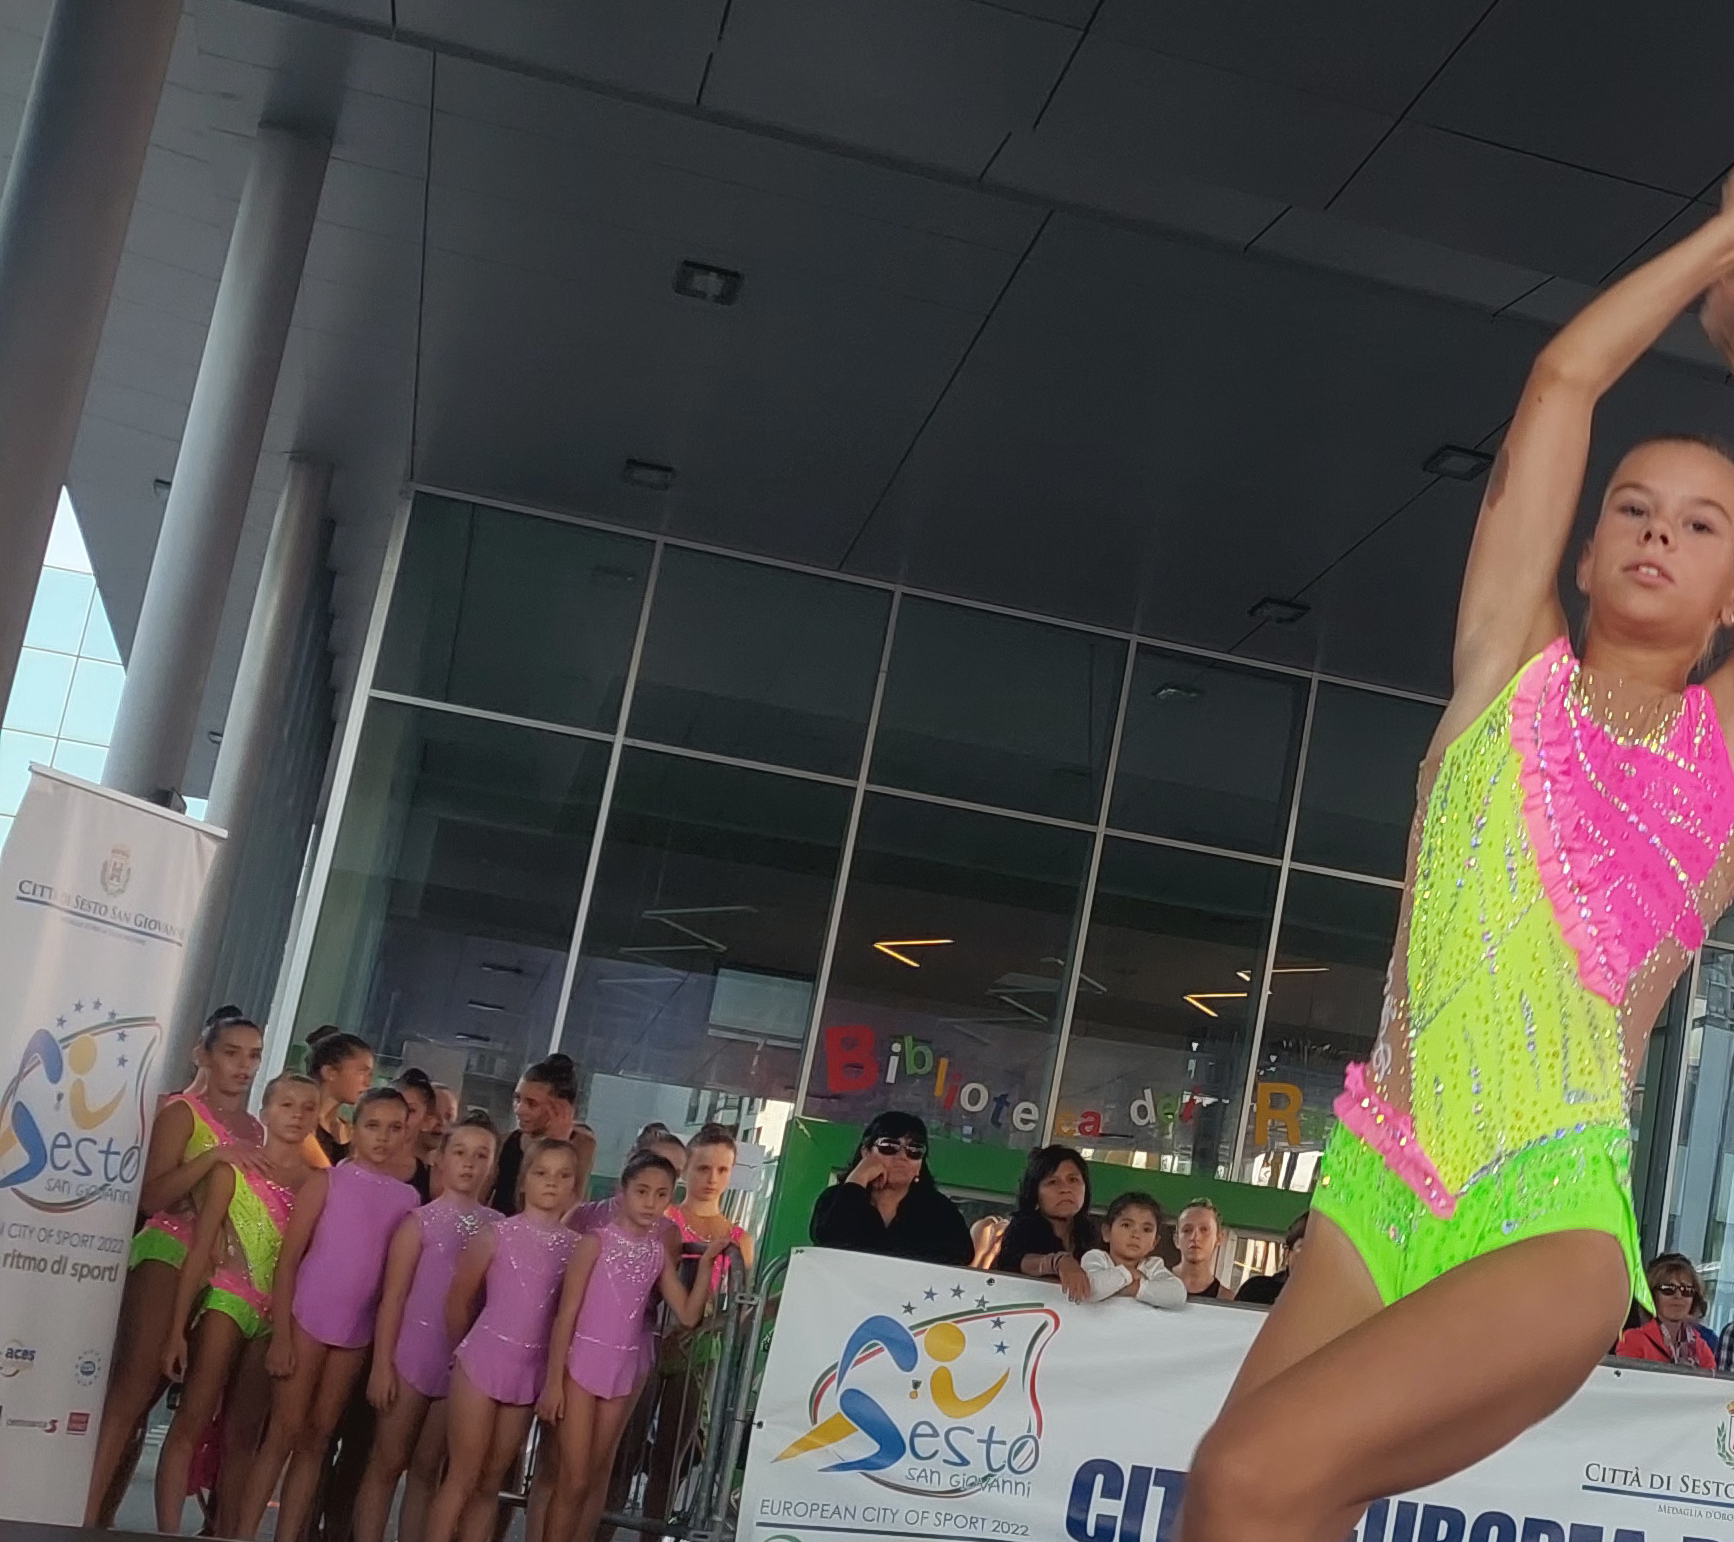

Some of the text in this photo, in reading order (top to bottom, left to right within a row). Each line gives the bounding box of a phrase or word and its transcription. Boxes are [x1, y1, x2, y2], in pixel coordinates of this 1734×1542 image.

[74, 894, 109, 916] SESTO
[110, 905, 131, 923] SAN
[825, 1024, 1102, 1137] Biblioteca
[7, 1223, 34, 1239] CITY
[37, 1227, 54, 1243] OF
[55, 1230, 96, 1249] SPORT
[2, 1250, 48, 1273] ritmo
[51, 1255, 68, 1275] di
[1585, 1462, 1641, 1488] CITTÀ
[1650, 1473, 1671, 1491] DI
[760, 1499, 1030, 1537] EUROPEAN CITY OF SPORT 2022
